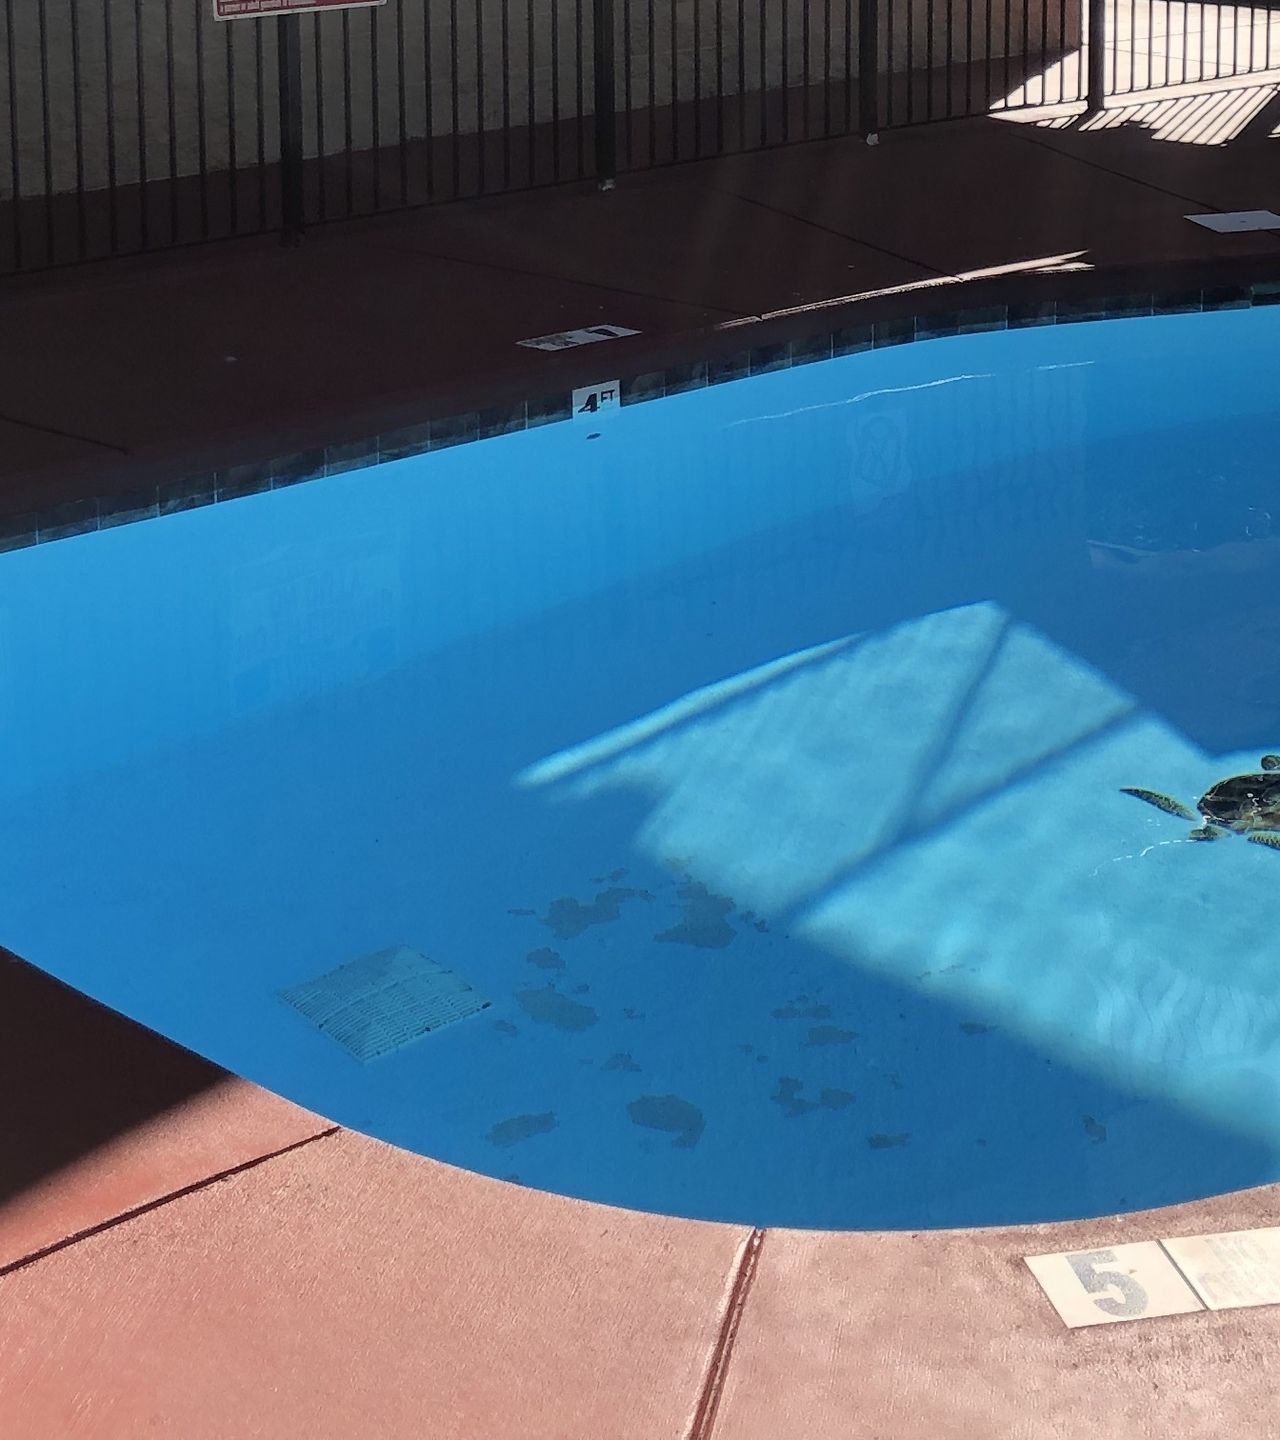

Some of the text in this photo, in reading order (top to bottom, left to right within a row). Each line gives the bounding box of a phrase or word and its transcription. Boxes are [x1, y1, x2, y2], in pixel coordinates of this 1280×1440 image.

[578, 389, 615, 413] 4 FT
[1065, 1249, 1150, 1317] 5
